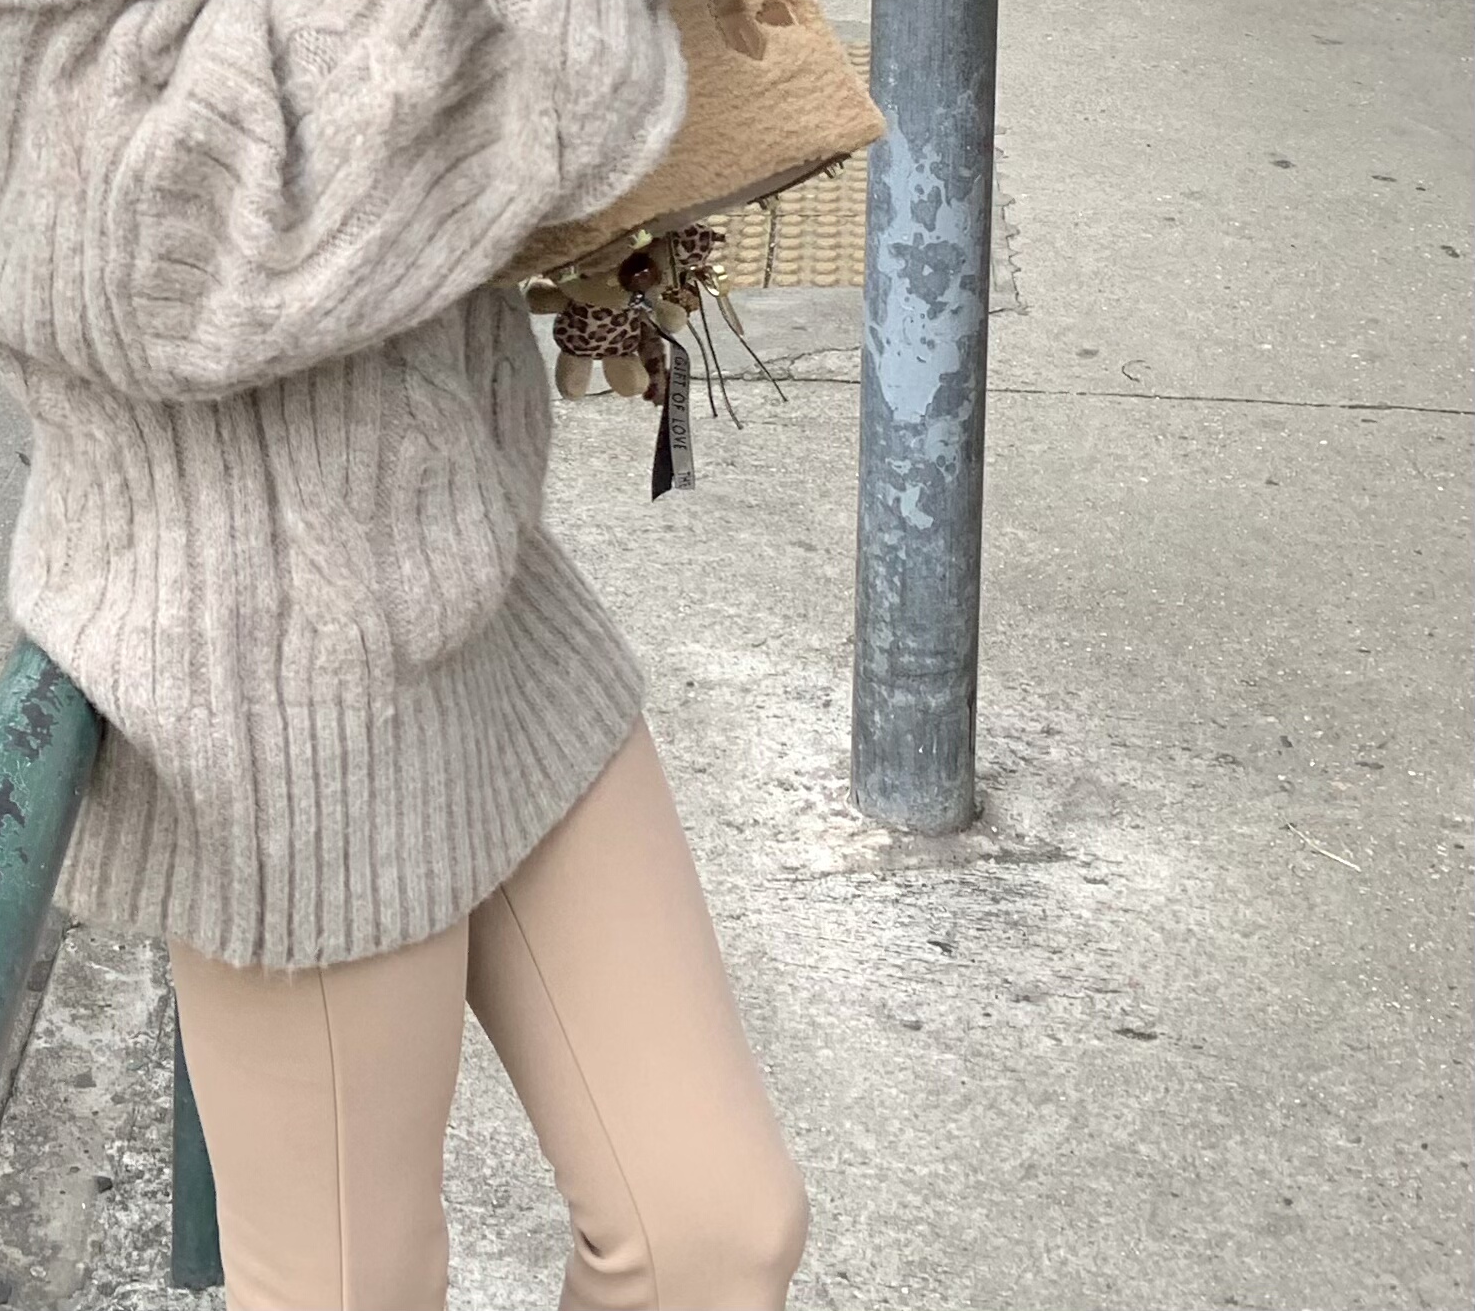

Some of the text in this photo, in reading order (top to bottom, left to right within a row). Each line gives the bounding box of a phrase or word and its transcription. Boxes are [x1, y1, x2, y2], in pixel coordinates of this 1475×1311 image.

[673, 356, 687, 388] GIFT
[671, 392, 686, 412] OF
[671, 418, 688, 451] LOVE
